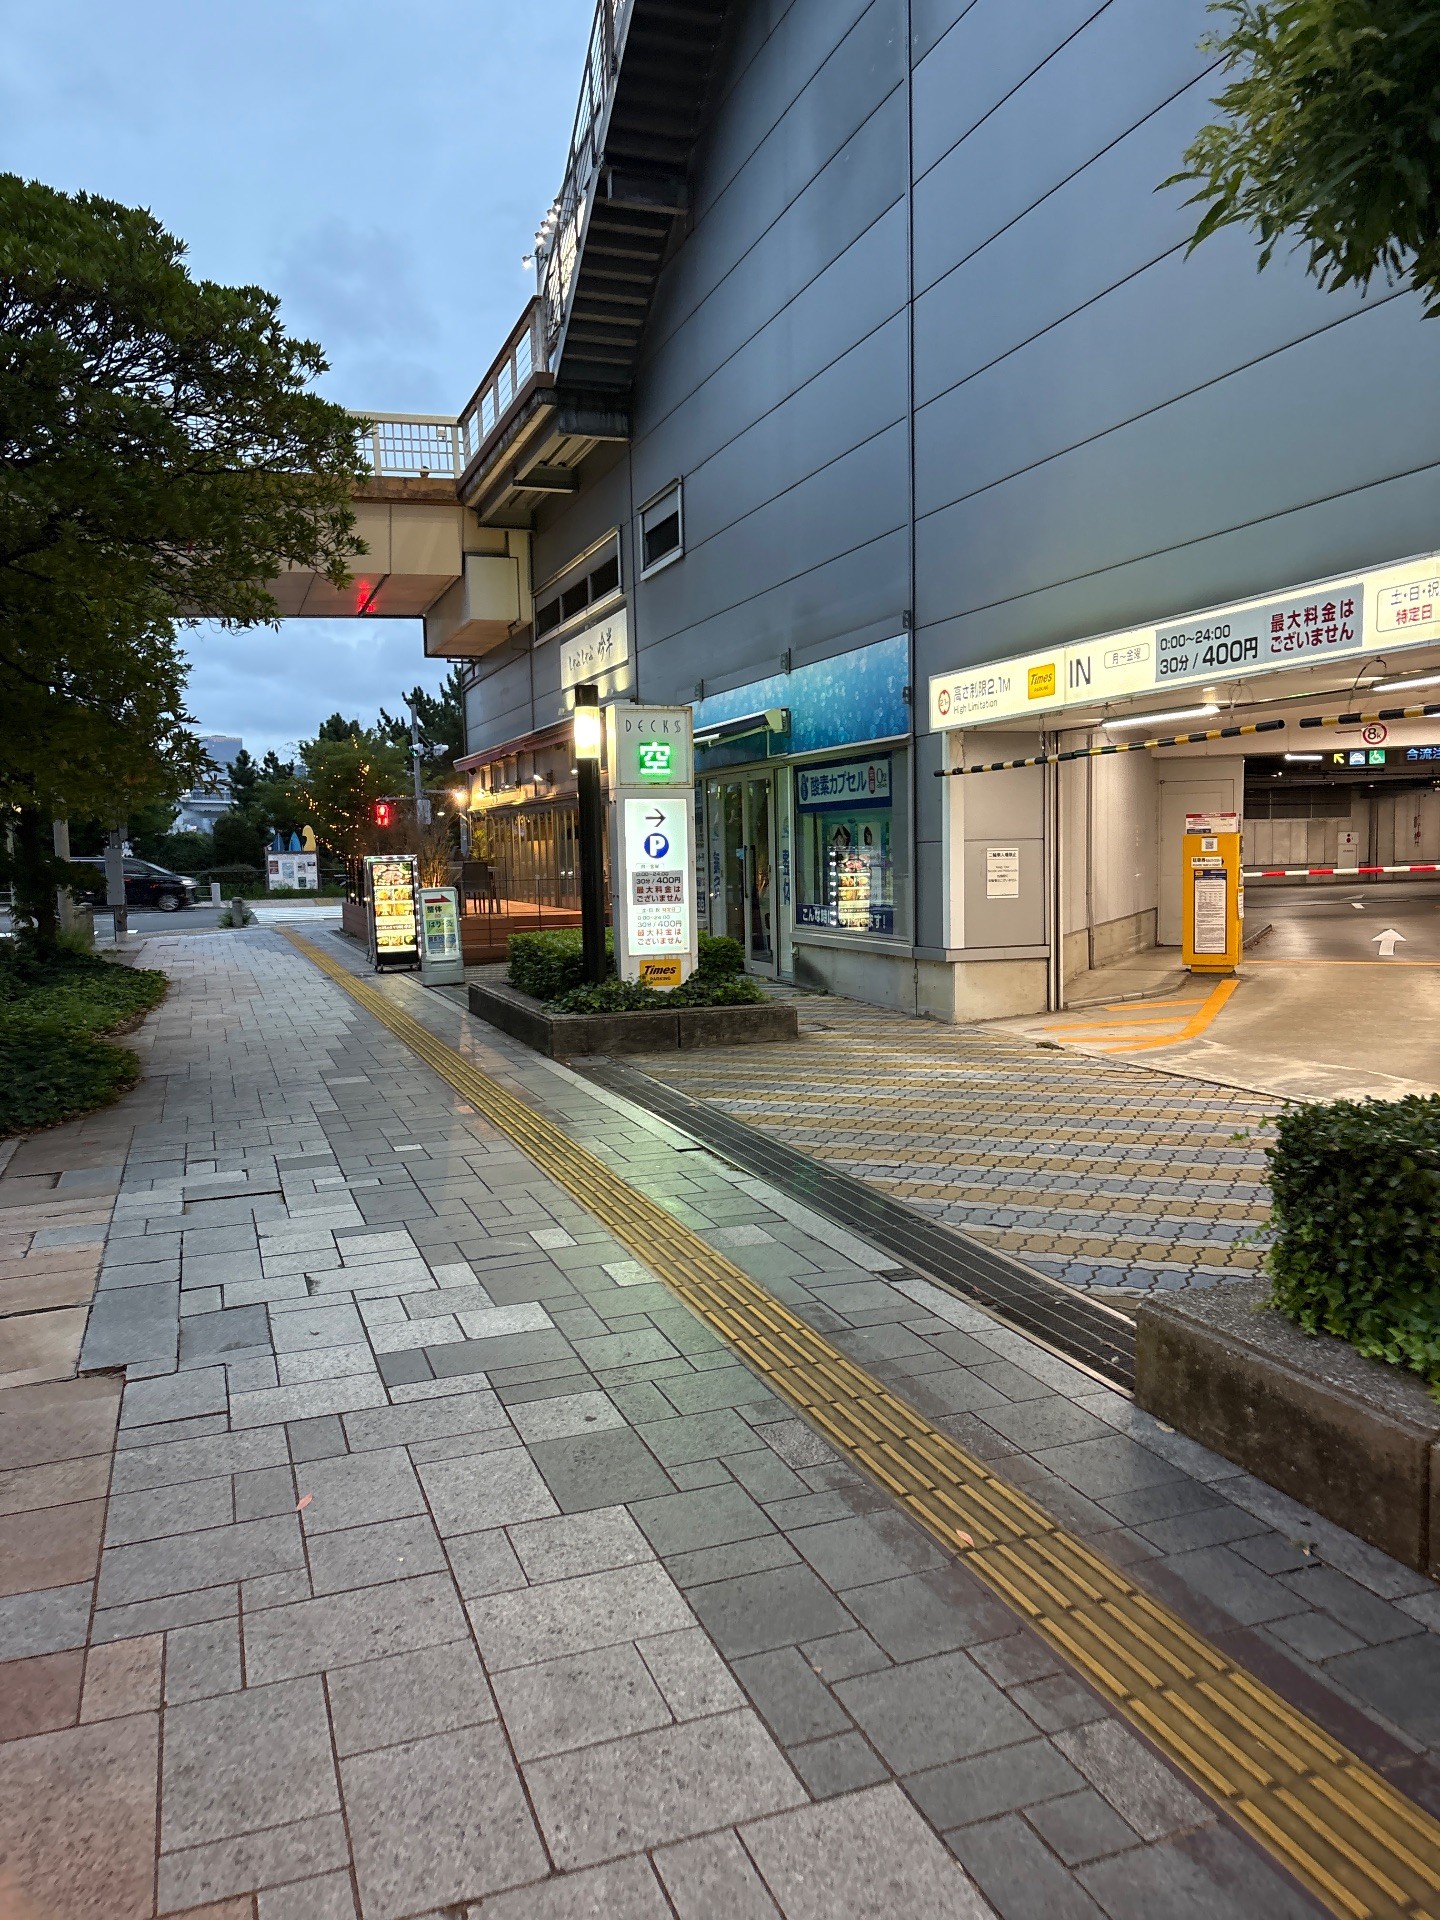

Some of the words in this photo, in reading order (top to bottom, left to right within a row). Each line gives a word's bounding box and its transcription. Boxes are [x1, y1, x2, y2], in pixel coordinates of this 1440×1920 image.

[1270, 598, 1354, 634] 最大料金は
[1395, 603, 1433, 626] 特定日
[1160, 624, 1231, 651] 0:00~24:00
[1270, 622, 1354, 653] ございません
[1159, 655, 1189, 675] 30分
[1202, 637, 1258, 667] 400円
[1030, 671, 1053, 686] Times
[1069, 656, 1091, 688] IN
[953, 703, 967, 714] High
[967, 699, 998, 713] Limitation
[626, 720, 681, 733] DECKS
[639, 741, 671, 774] 空
[811, 771, 867, 797] 酸素カプセル
[650, 835, 666, 857] P
[636, 885, 681, 894] 最大料金は
[636, 894, 681, 903] ございません
[637, 928, 682, 937] 最大料金は
[637, 937, 682, 946] ございません
[644, 964, 677, 975] Times
